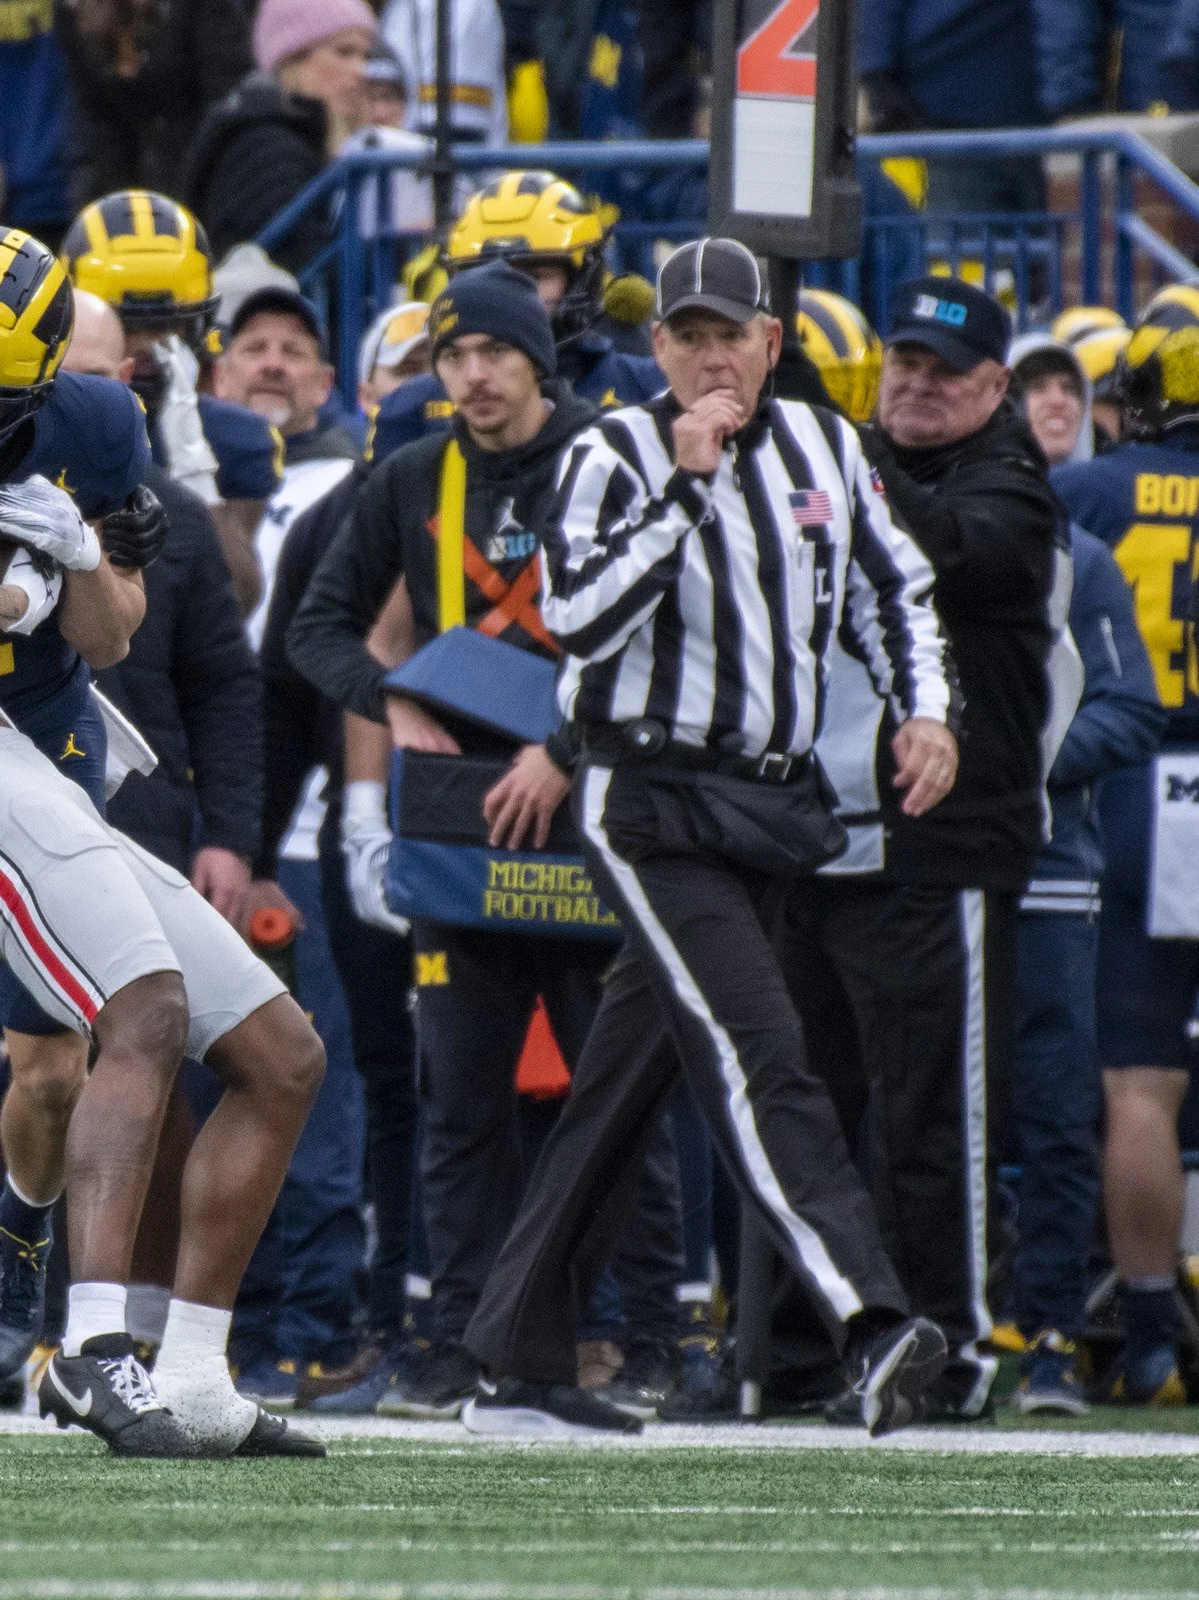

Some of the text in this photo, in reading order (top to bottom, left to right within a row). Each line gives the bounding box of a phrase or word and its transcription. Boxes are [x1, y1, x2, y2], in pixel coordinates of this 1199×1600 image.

[815, 567, 833, 604] L
[488, 860, 593, 893] MICHIG
[485, 889, 621, 926] FOOTBAL
[416, 952, 450, 986] M
